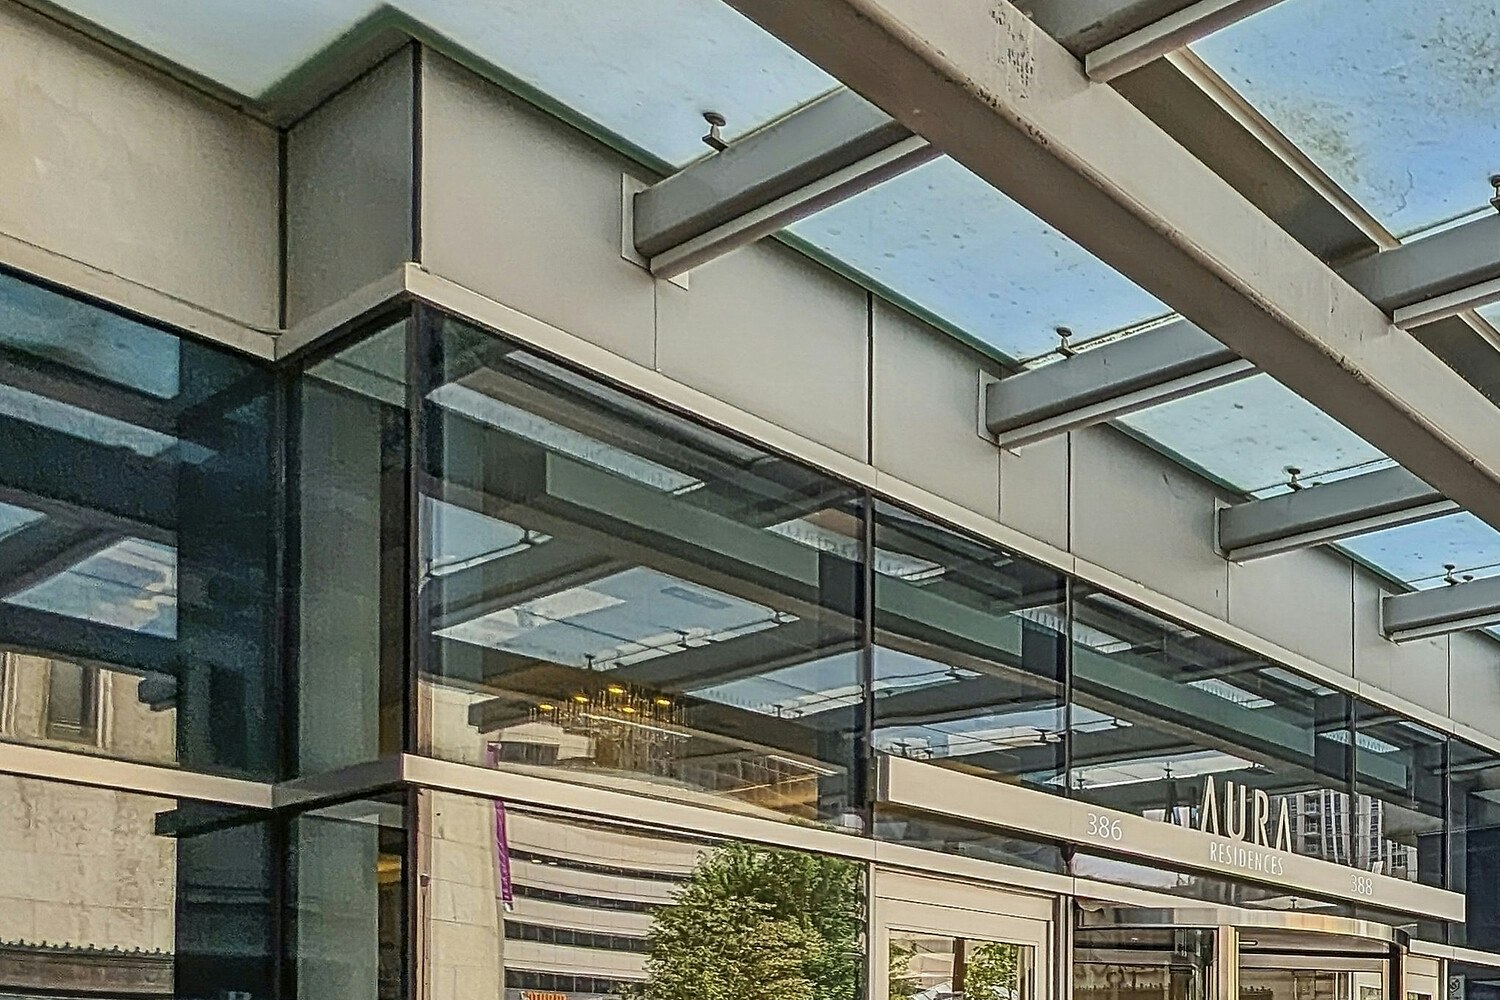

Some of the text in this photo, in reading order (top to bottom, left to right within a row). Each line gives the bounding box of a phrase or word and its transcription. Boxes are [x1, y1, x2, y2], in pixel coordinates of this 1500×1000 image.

[1087, 813, 1123, 841] 386
[1201, 775, 1292, 853] AURA
[1210, 842, 1283, 876] RESIDENCES
[1351, 874, 1373, 895] 388
